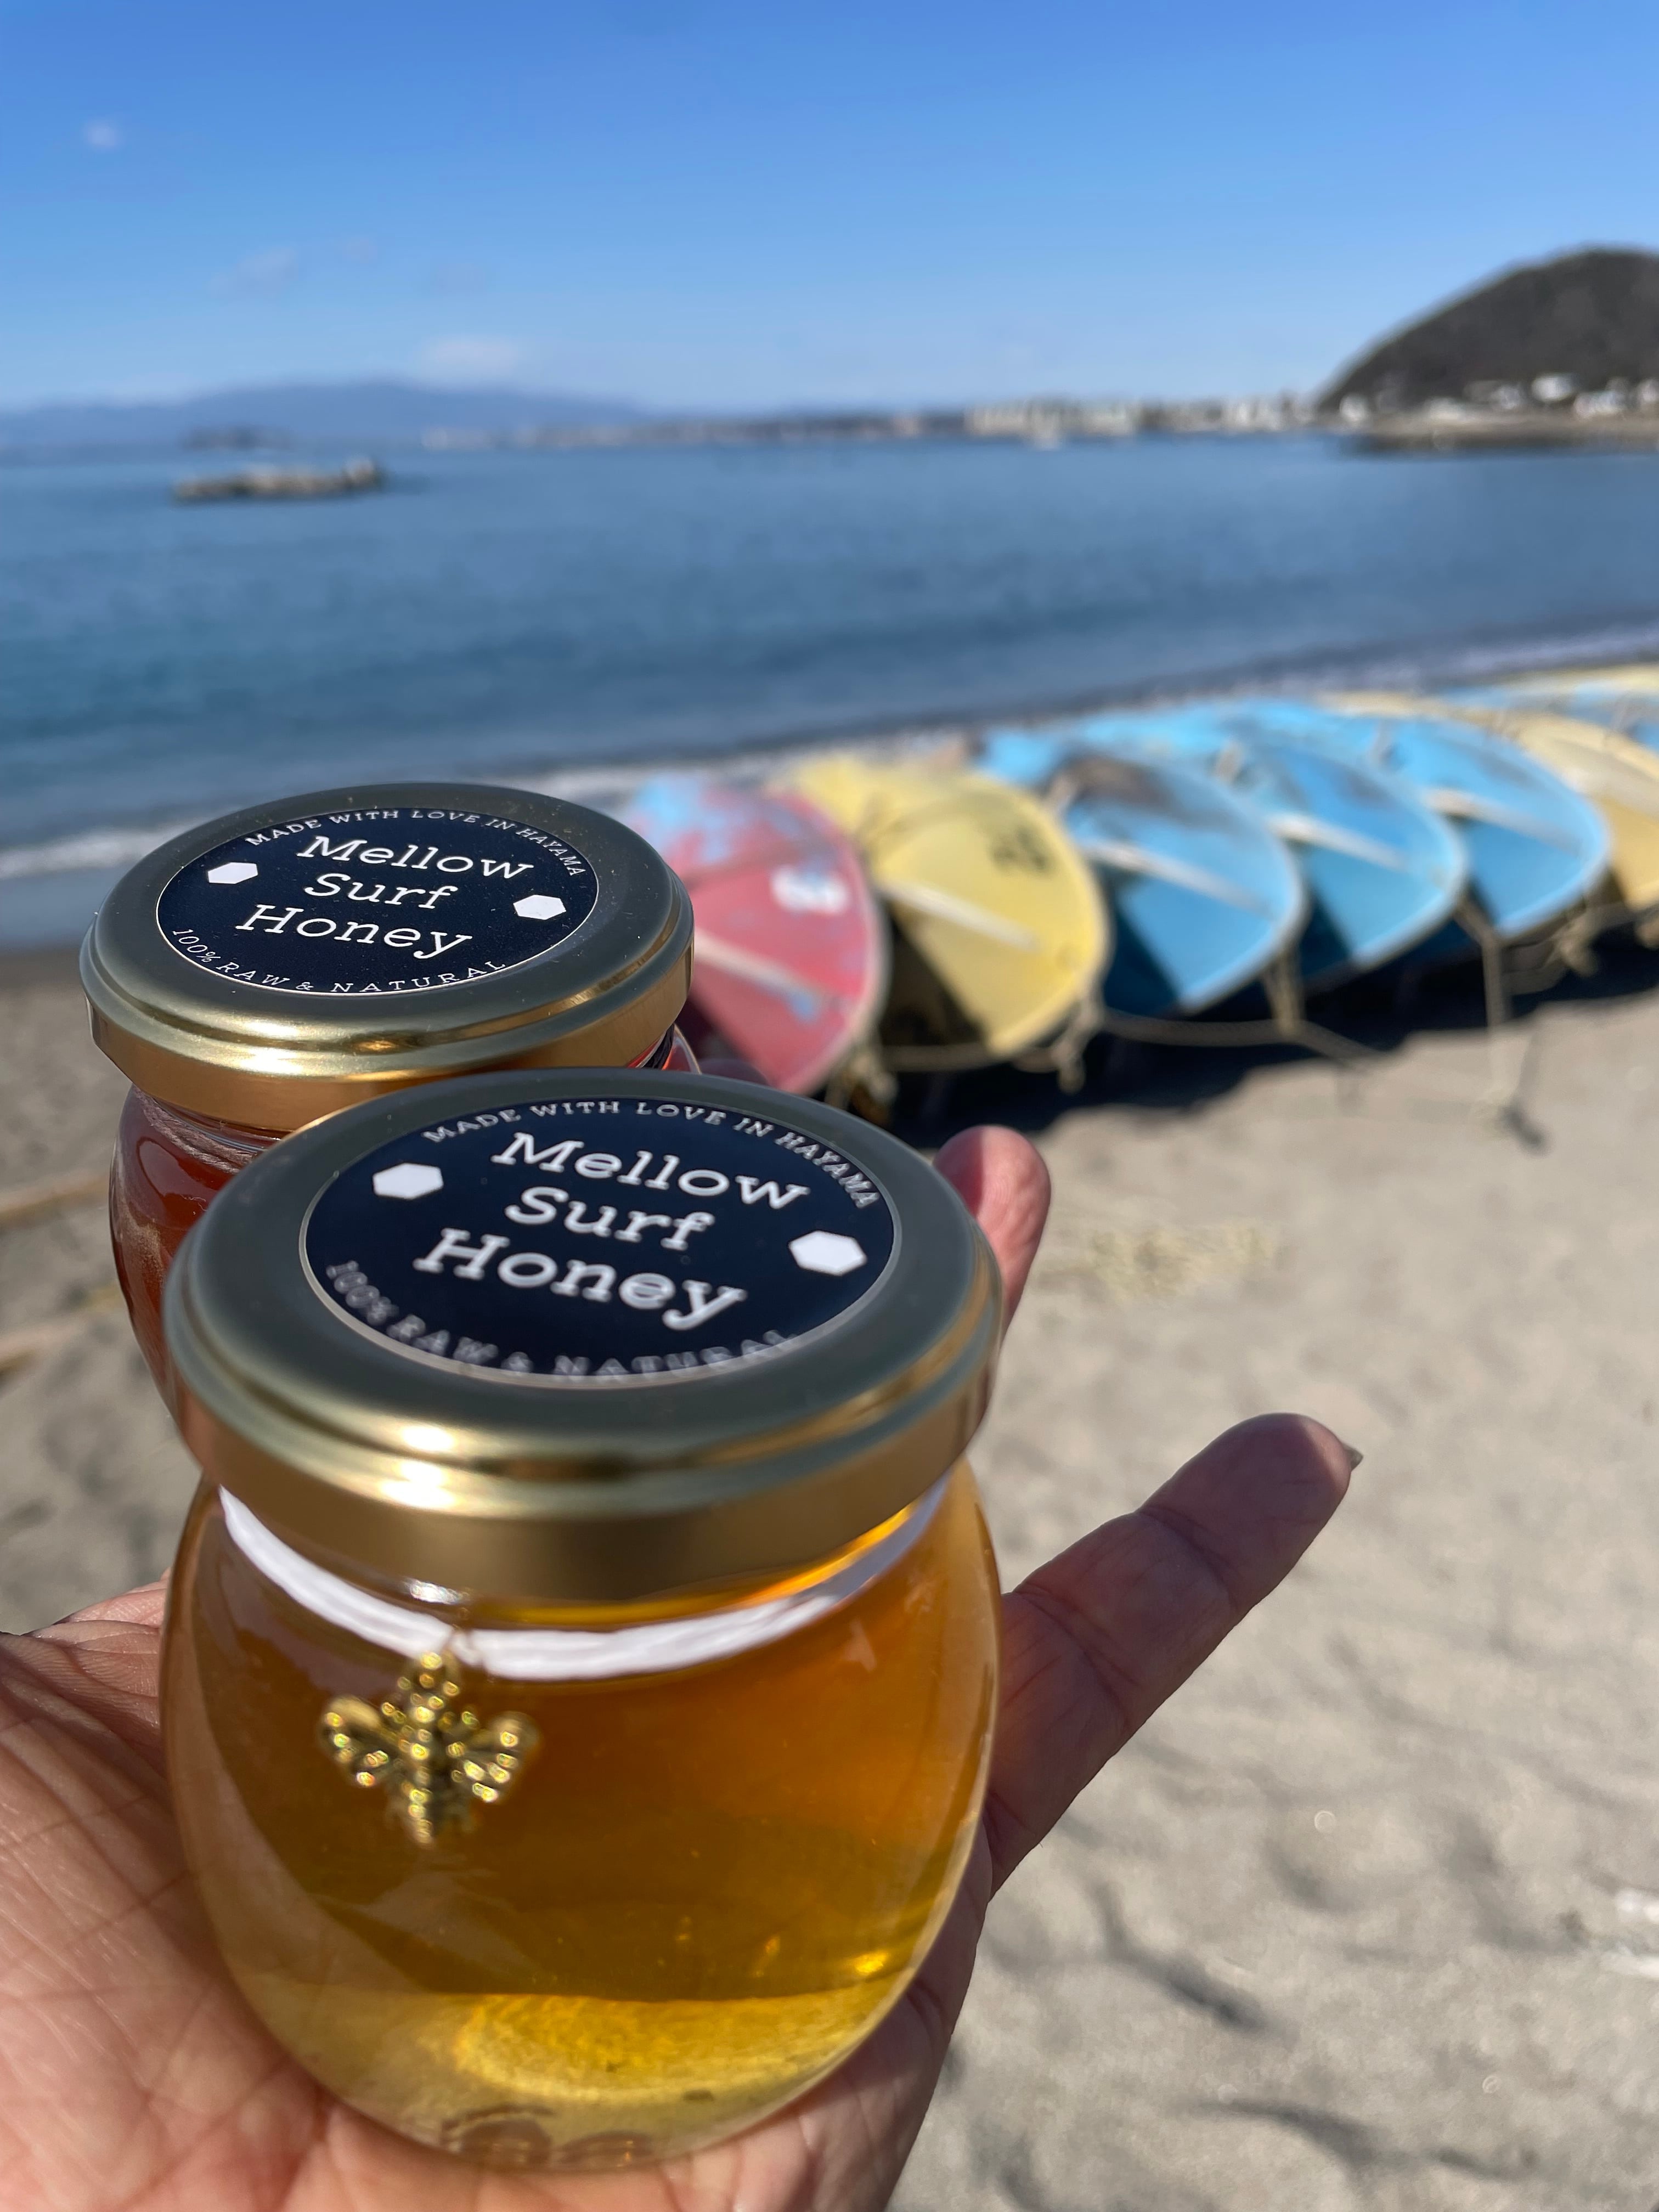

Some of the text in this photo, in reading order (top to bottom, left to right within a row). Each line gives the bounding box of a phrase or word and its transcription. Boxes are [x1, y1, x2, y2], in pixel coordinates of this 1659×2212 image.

[245, 810, 586, 876] MADE WITH LOVE IN HAYAMA
[296, 836, 534, 879] Mellow
[304, 873, 458, 909] Surf
[172, 929, 506, 992] 100% RAW & NATURAL
[235, 904, 472, 959] Honey
[422, 1101, 879, 1208] MADE WITH LOVE IN HAYAMA
[490, 1132, 811, 1209] Mellow
[505, 1187, 715, 1250] Surf
[413, 1228, 748, 1330] Honey
